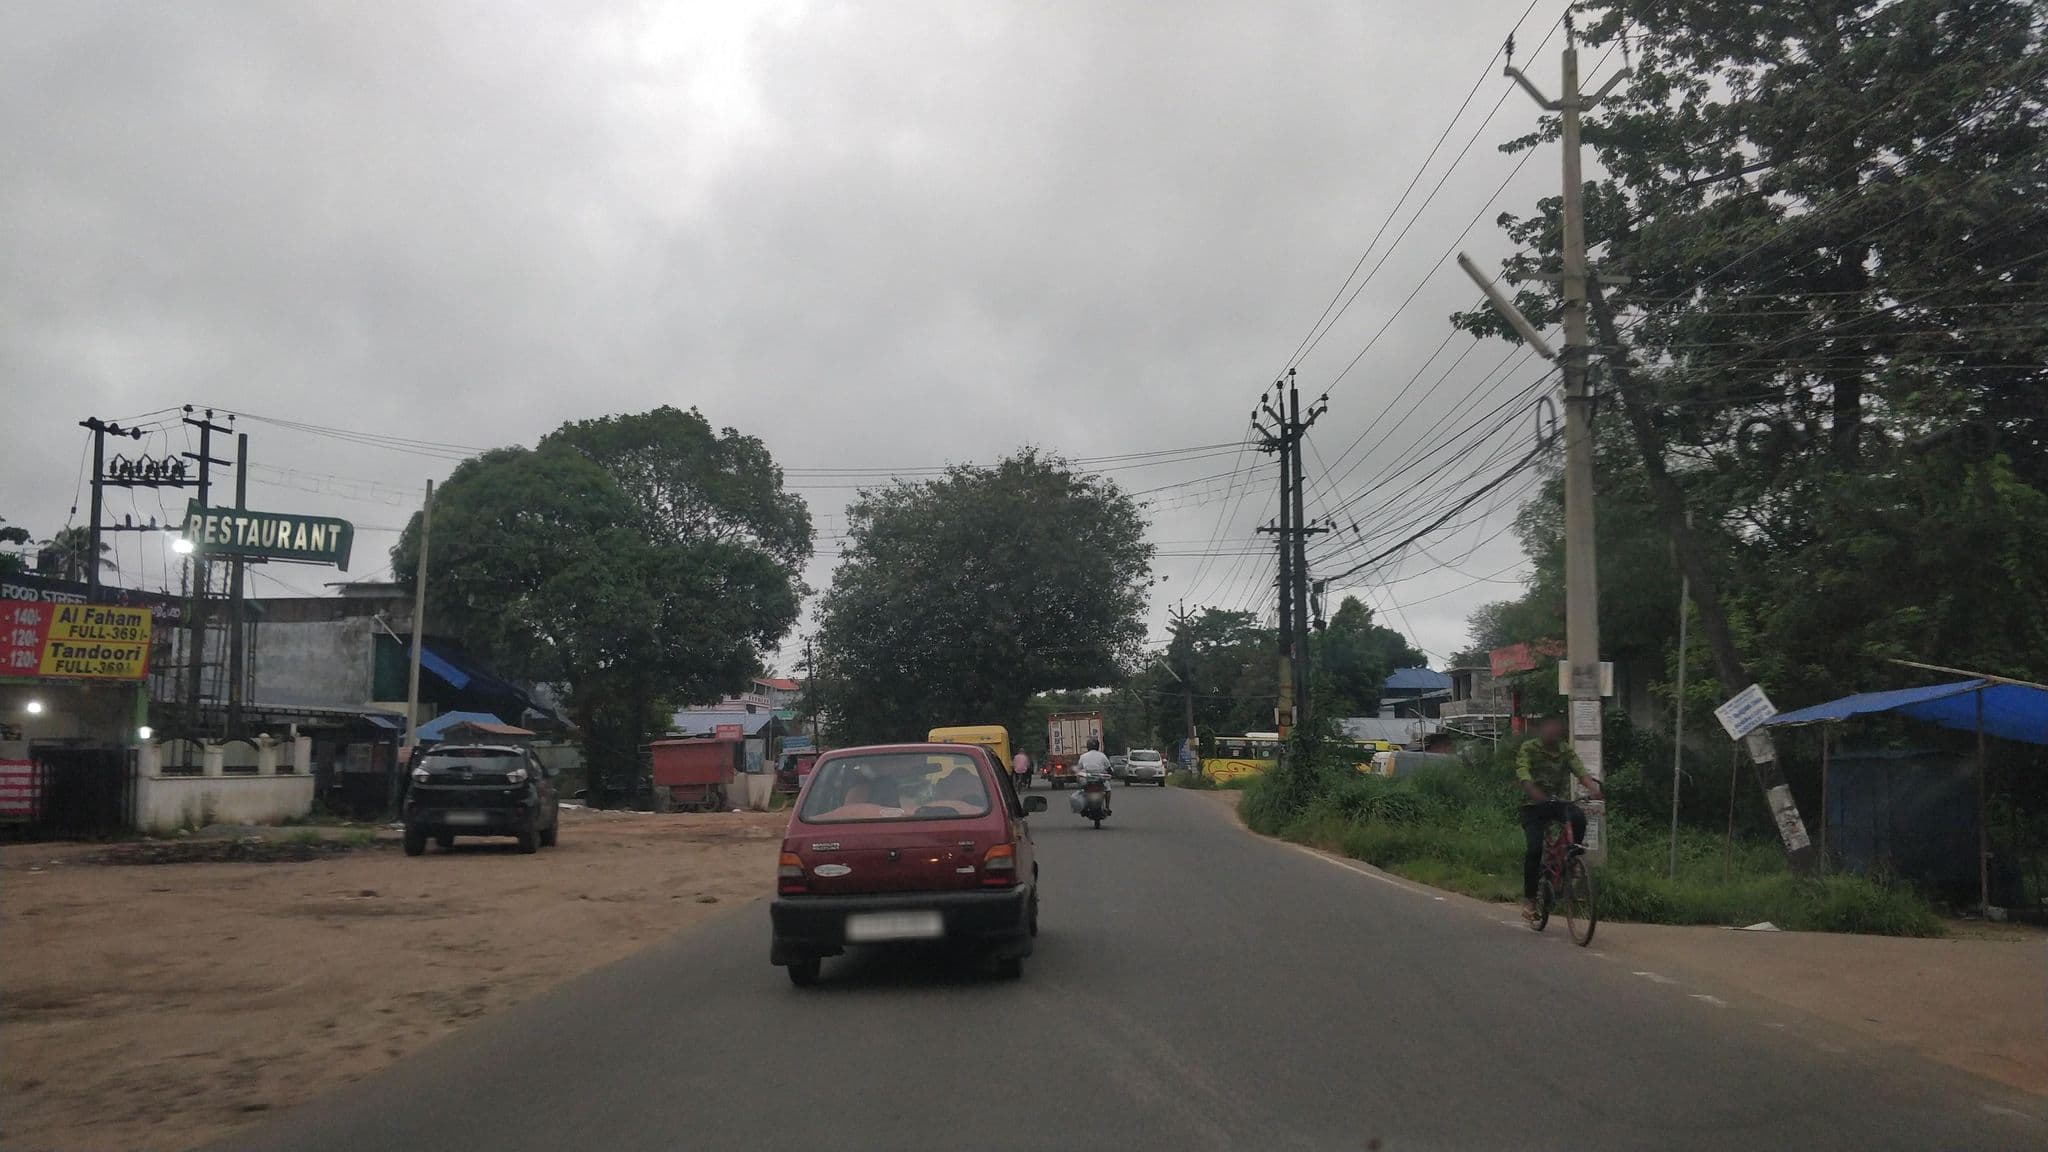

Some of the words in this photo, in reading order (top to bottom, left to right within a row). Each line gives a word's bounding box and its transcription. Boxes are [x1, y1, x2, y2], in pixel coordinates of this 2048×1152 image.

[189, 513, 342, 553] RESTAURANT
[2, 583, 39, 602] FOOD
[59, 607, 79, 624] Al
[84, 608, 142, 626] Faham
[52, 642, 141, 661] Tandoori
